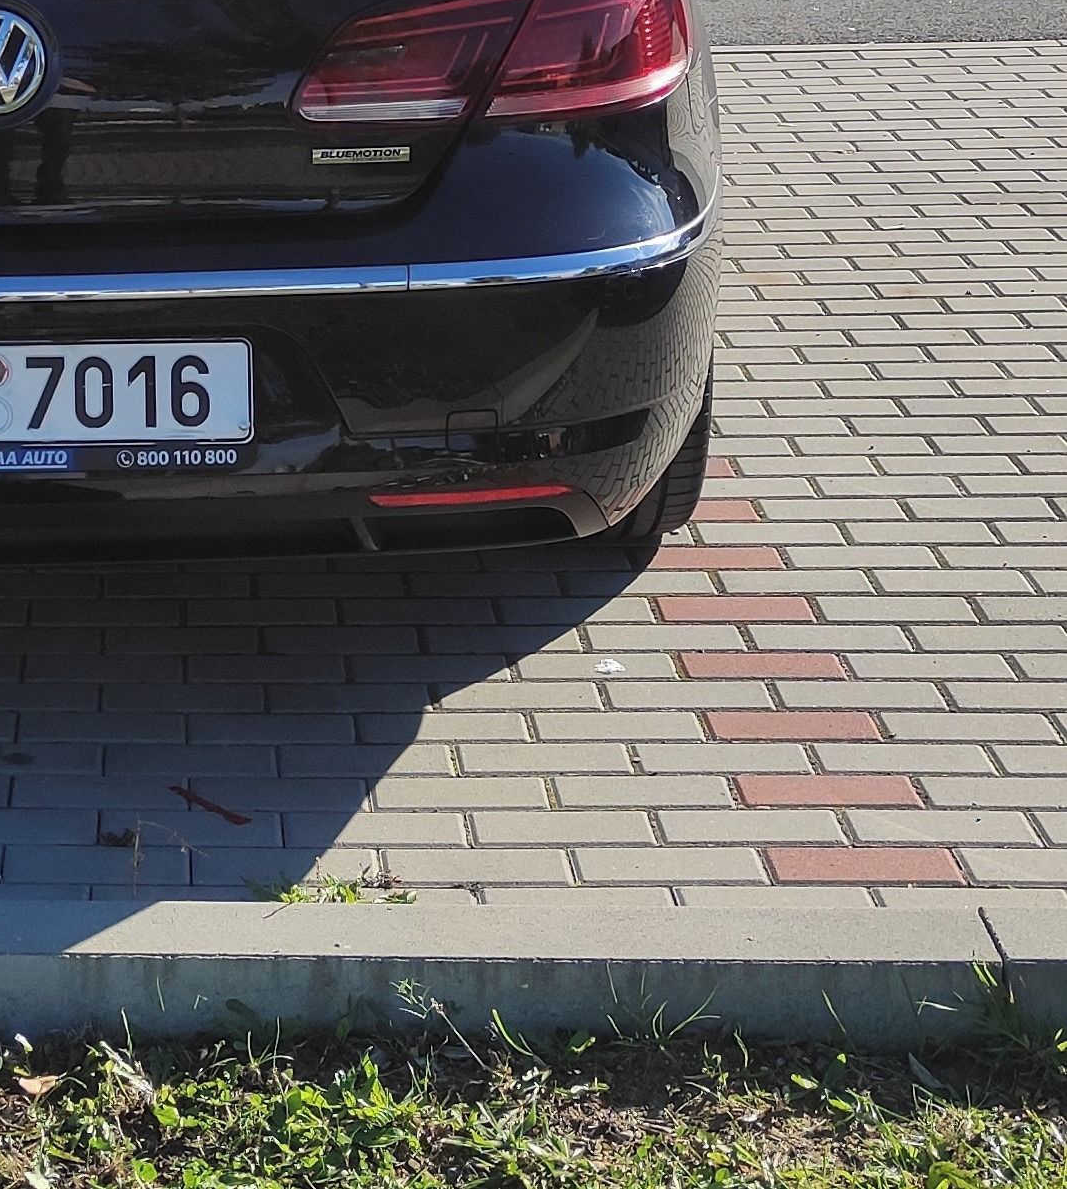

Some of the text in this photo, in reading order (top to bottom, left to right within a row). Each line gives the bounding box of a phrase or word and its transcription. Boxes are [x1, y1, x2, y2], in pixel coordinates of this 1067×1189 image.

[320, 149, 401, 159] BLUEMOTION
[25, 355, 210, 430] 7016
[21, 450, 67, 464] AUTO
[137, 449, 237, 466] 800 110 800
